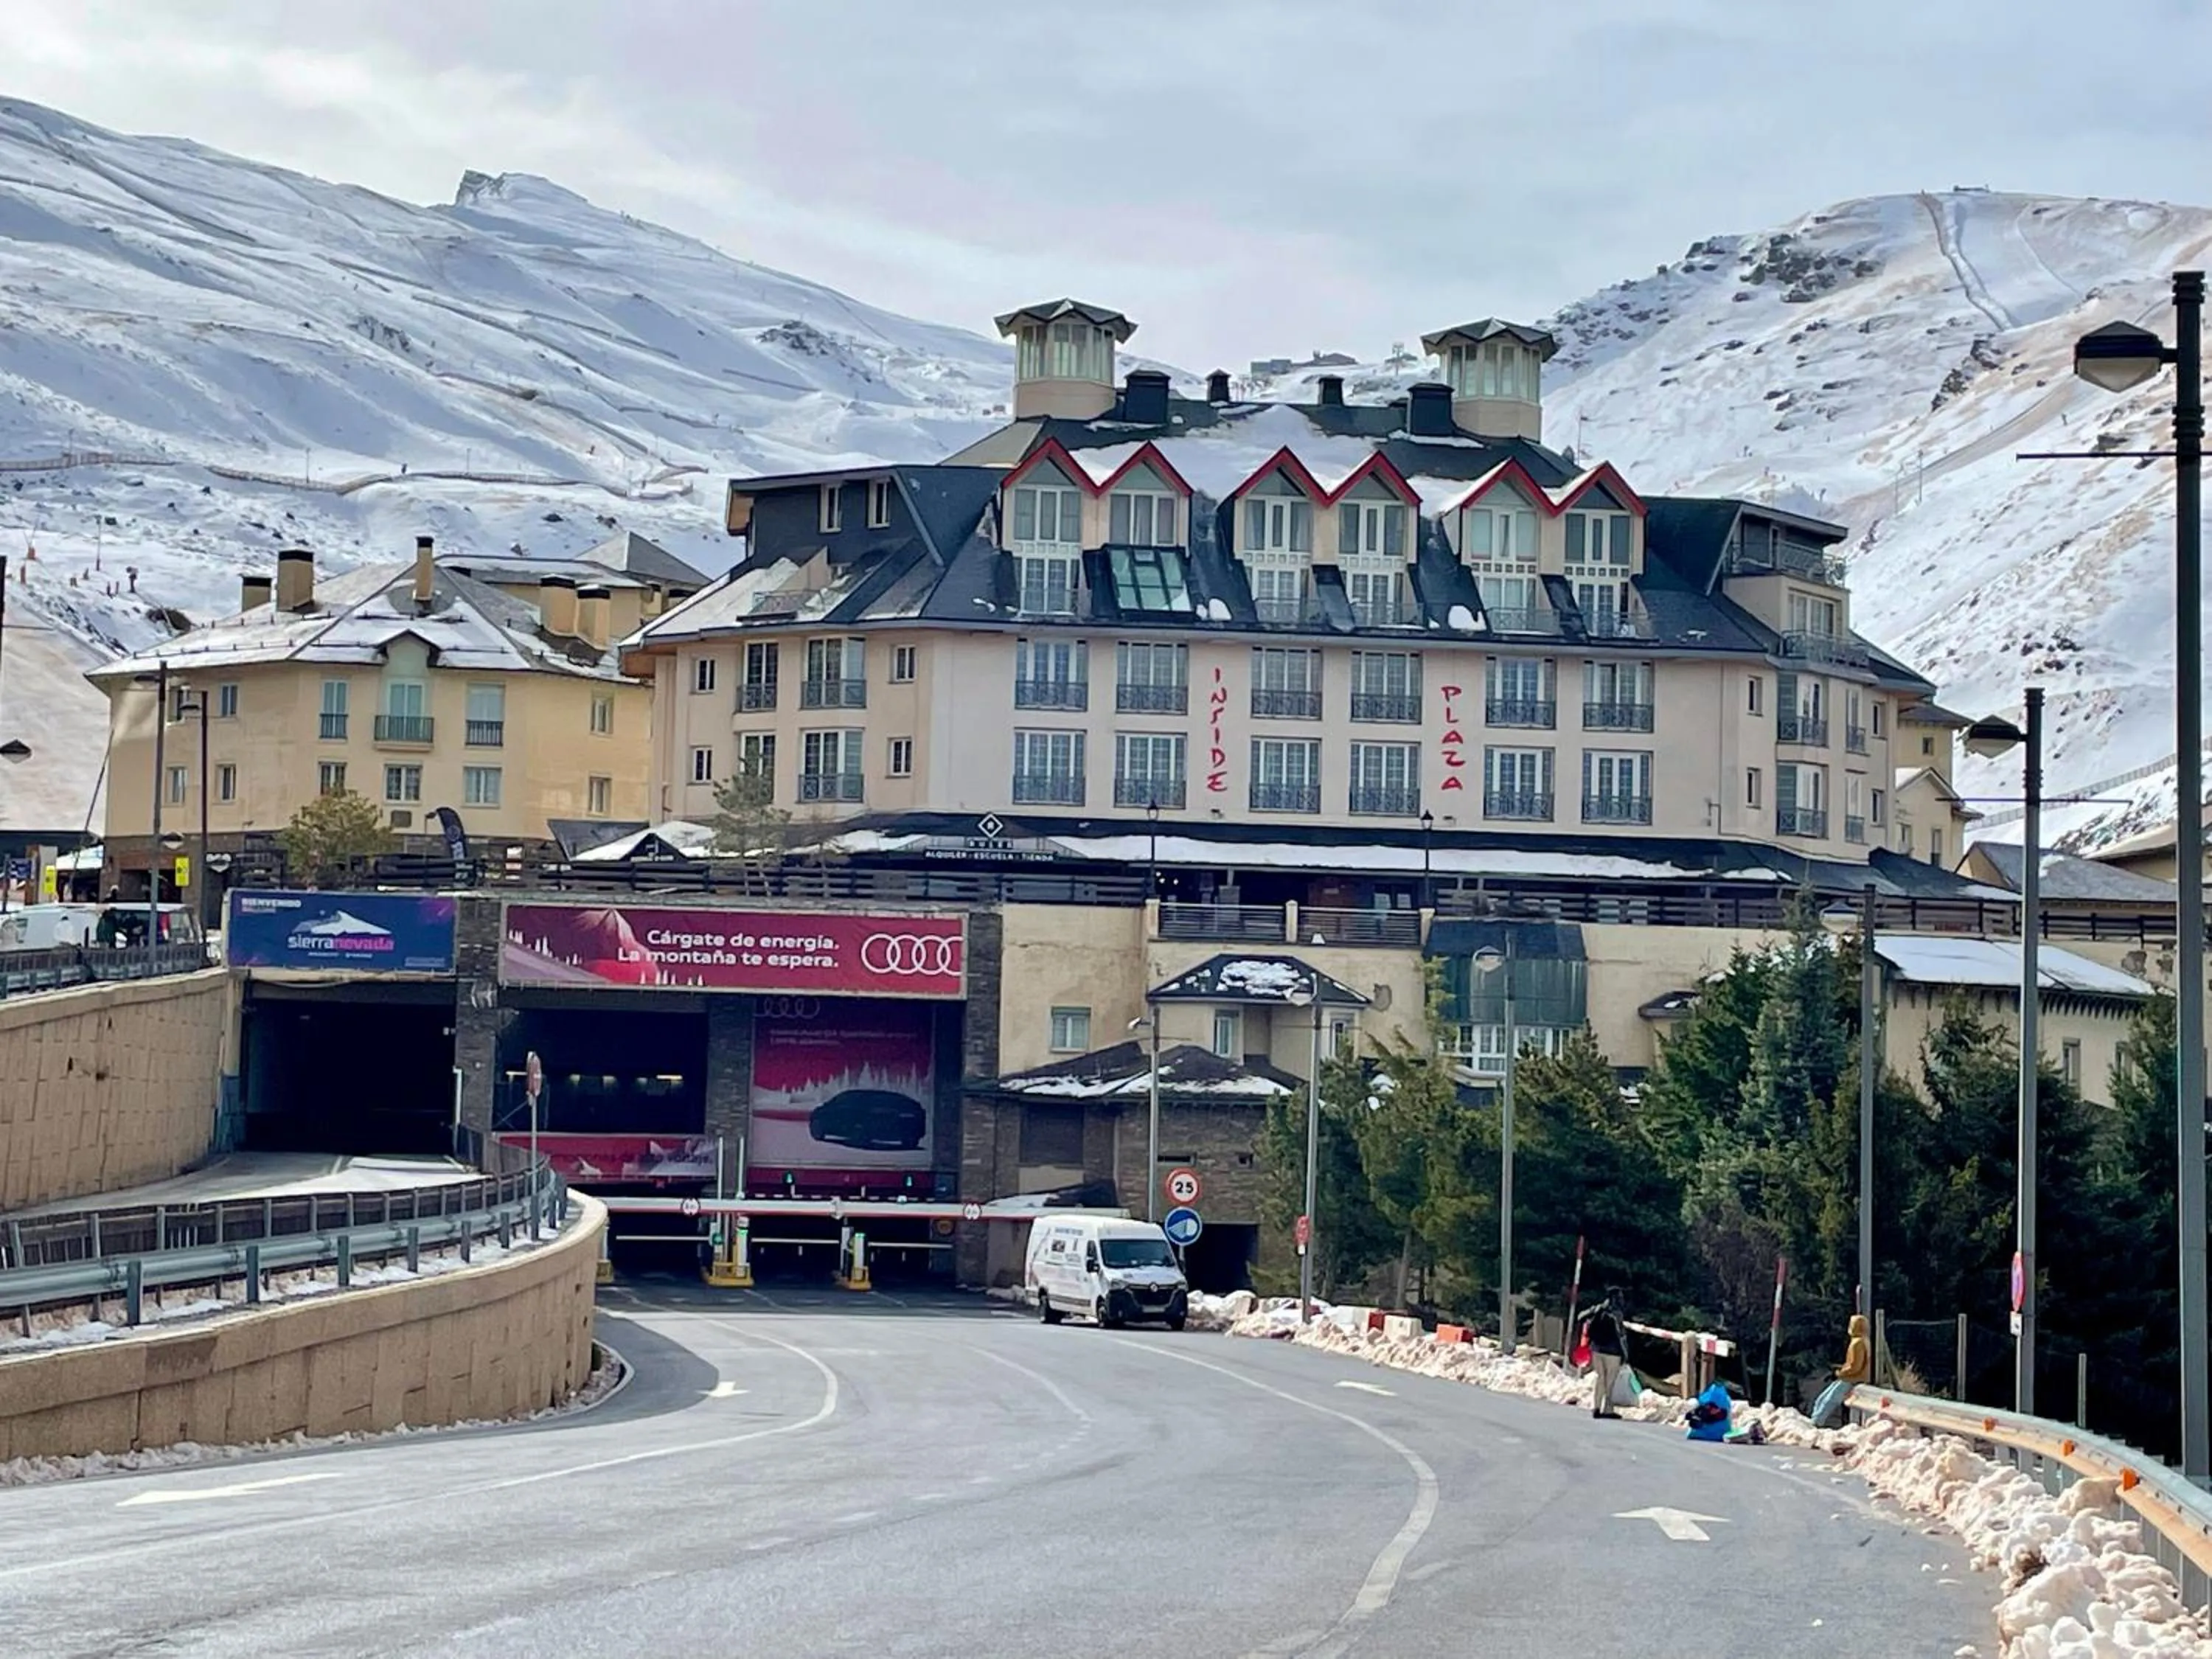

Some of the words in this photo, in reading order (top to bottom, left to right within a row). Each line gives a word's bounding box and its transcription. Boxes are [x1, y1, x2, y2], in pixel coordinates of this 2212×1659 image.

[1207, 667, 1228, 792] INSIDE
[1441, 686, 1466, 790] PLAZA
[647, 930, 726, 948] Cárgate
[730, 933, 755, 947] de
[759, 935, 840, 951] energía.
[618, 947, 640, 962] La
[646, 950, 737, 965] montaña
[741, 952, 763, 966] te
[768, 954, 839, 970] espera.
[1175, 1181, 1194, 1194] 25
